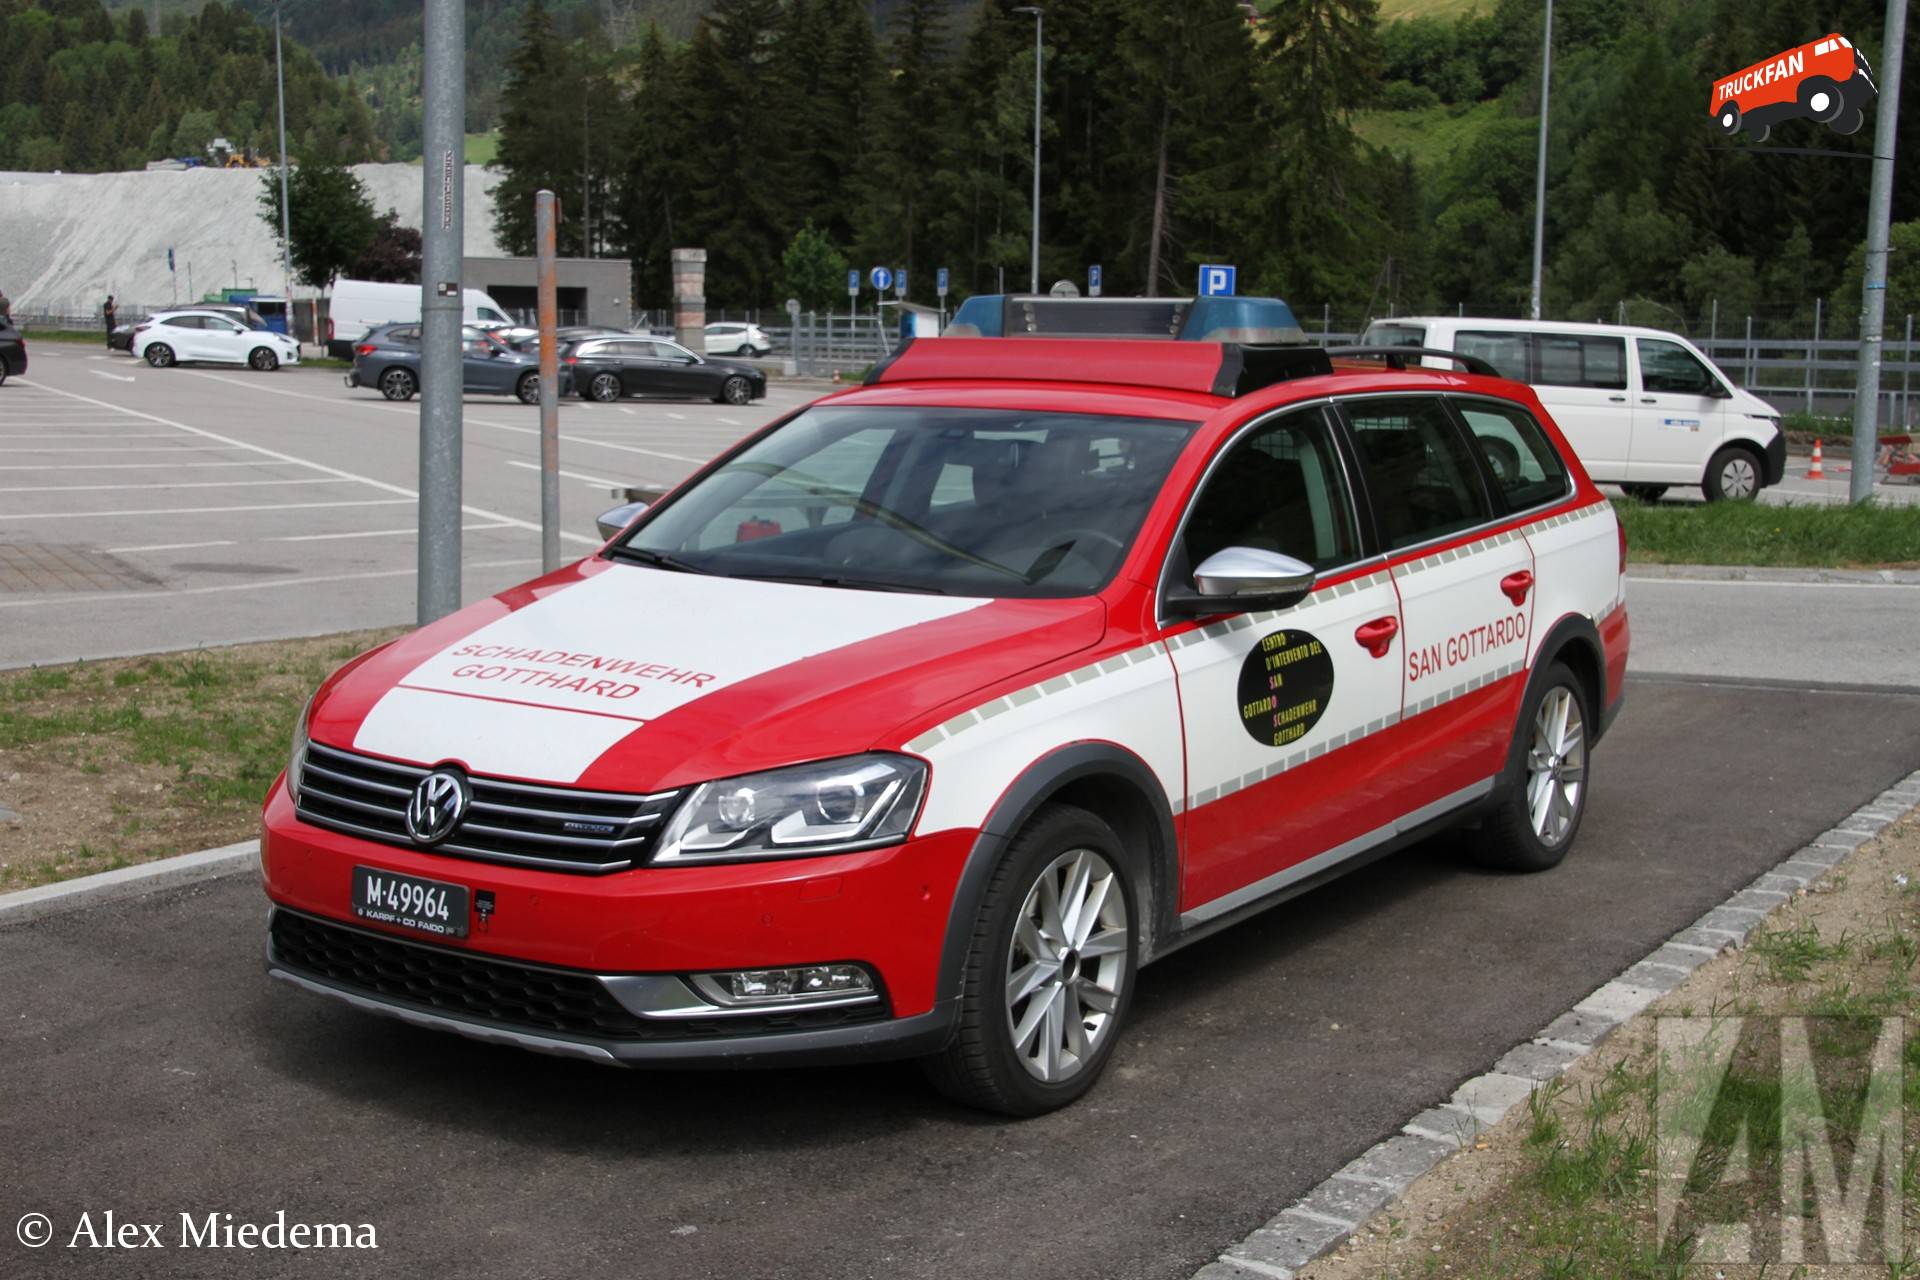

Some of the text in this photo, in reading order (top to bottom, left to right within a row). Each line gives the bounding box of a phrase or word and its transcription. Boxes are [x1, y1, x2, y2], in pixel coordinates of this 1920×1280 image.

[1209, 270, 1227, 295] P
[1262, 632, 1287, 653] CENTRO
[1309, 640, 1322, 656] DEL
[1409, 612, 1526, 682] SAN GOTTARDO
[452, 644, 717, 689] SCHADENWEHR
[452, 663, 641, 700] GOTTHARD
[1269, 672, 1283, 690] SAN
[1243, 695, 1277, 720] GOTTARDO
[1273, 699, 1317, 728] SCHADENWEHR
[1273, 723, 1305, 747] GOTTHARD
[366, 910, 395, 922] KARPF
[402, 917, 416, 927] CO
[418, 921, 445, 934] FAIDO
